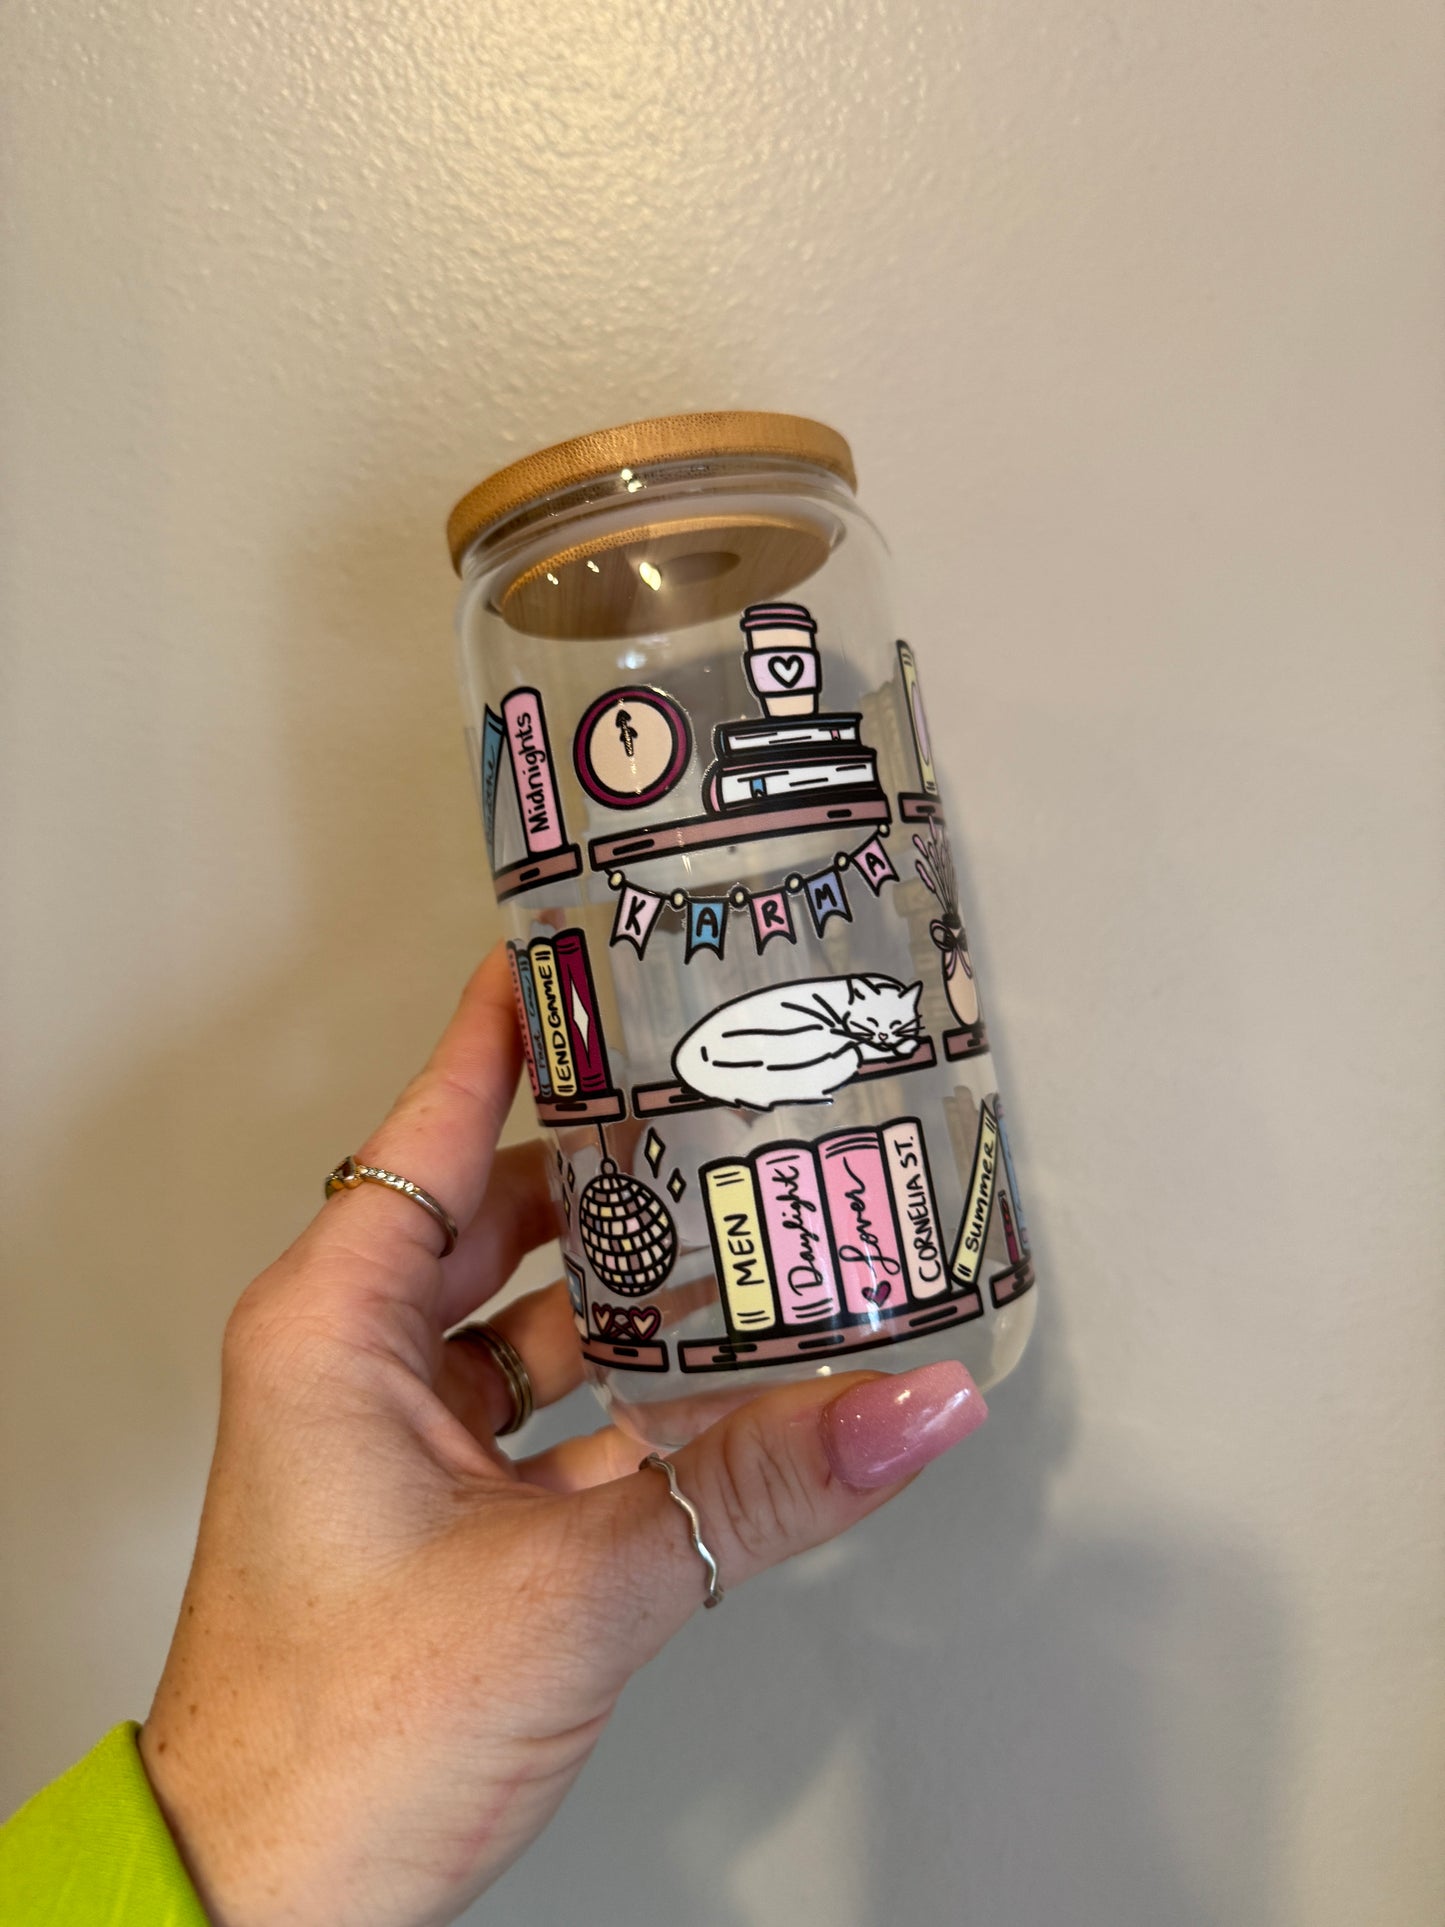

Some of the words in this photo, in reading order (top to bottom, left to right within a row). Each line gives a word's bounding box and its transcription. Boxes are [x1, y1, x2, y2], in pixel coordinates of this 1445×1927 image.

[515, 711, 551, 834] Midnights
[624, 852, 886, 938] KARMA
[893, 1135, 927, 1169] ST.
[723, 1213, 765, 1286] MEN
[771, 1165, 824, 1297] Daylight
[838, 1156, 900, 1276] Lover
[905, 1173, 942, 1283] CORNELIA
